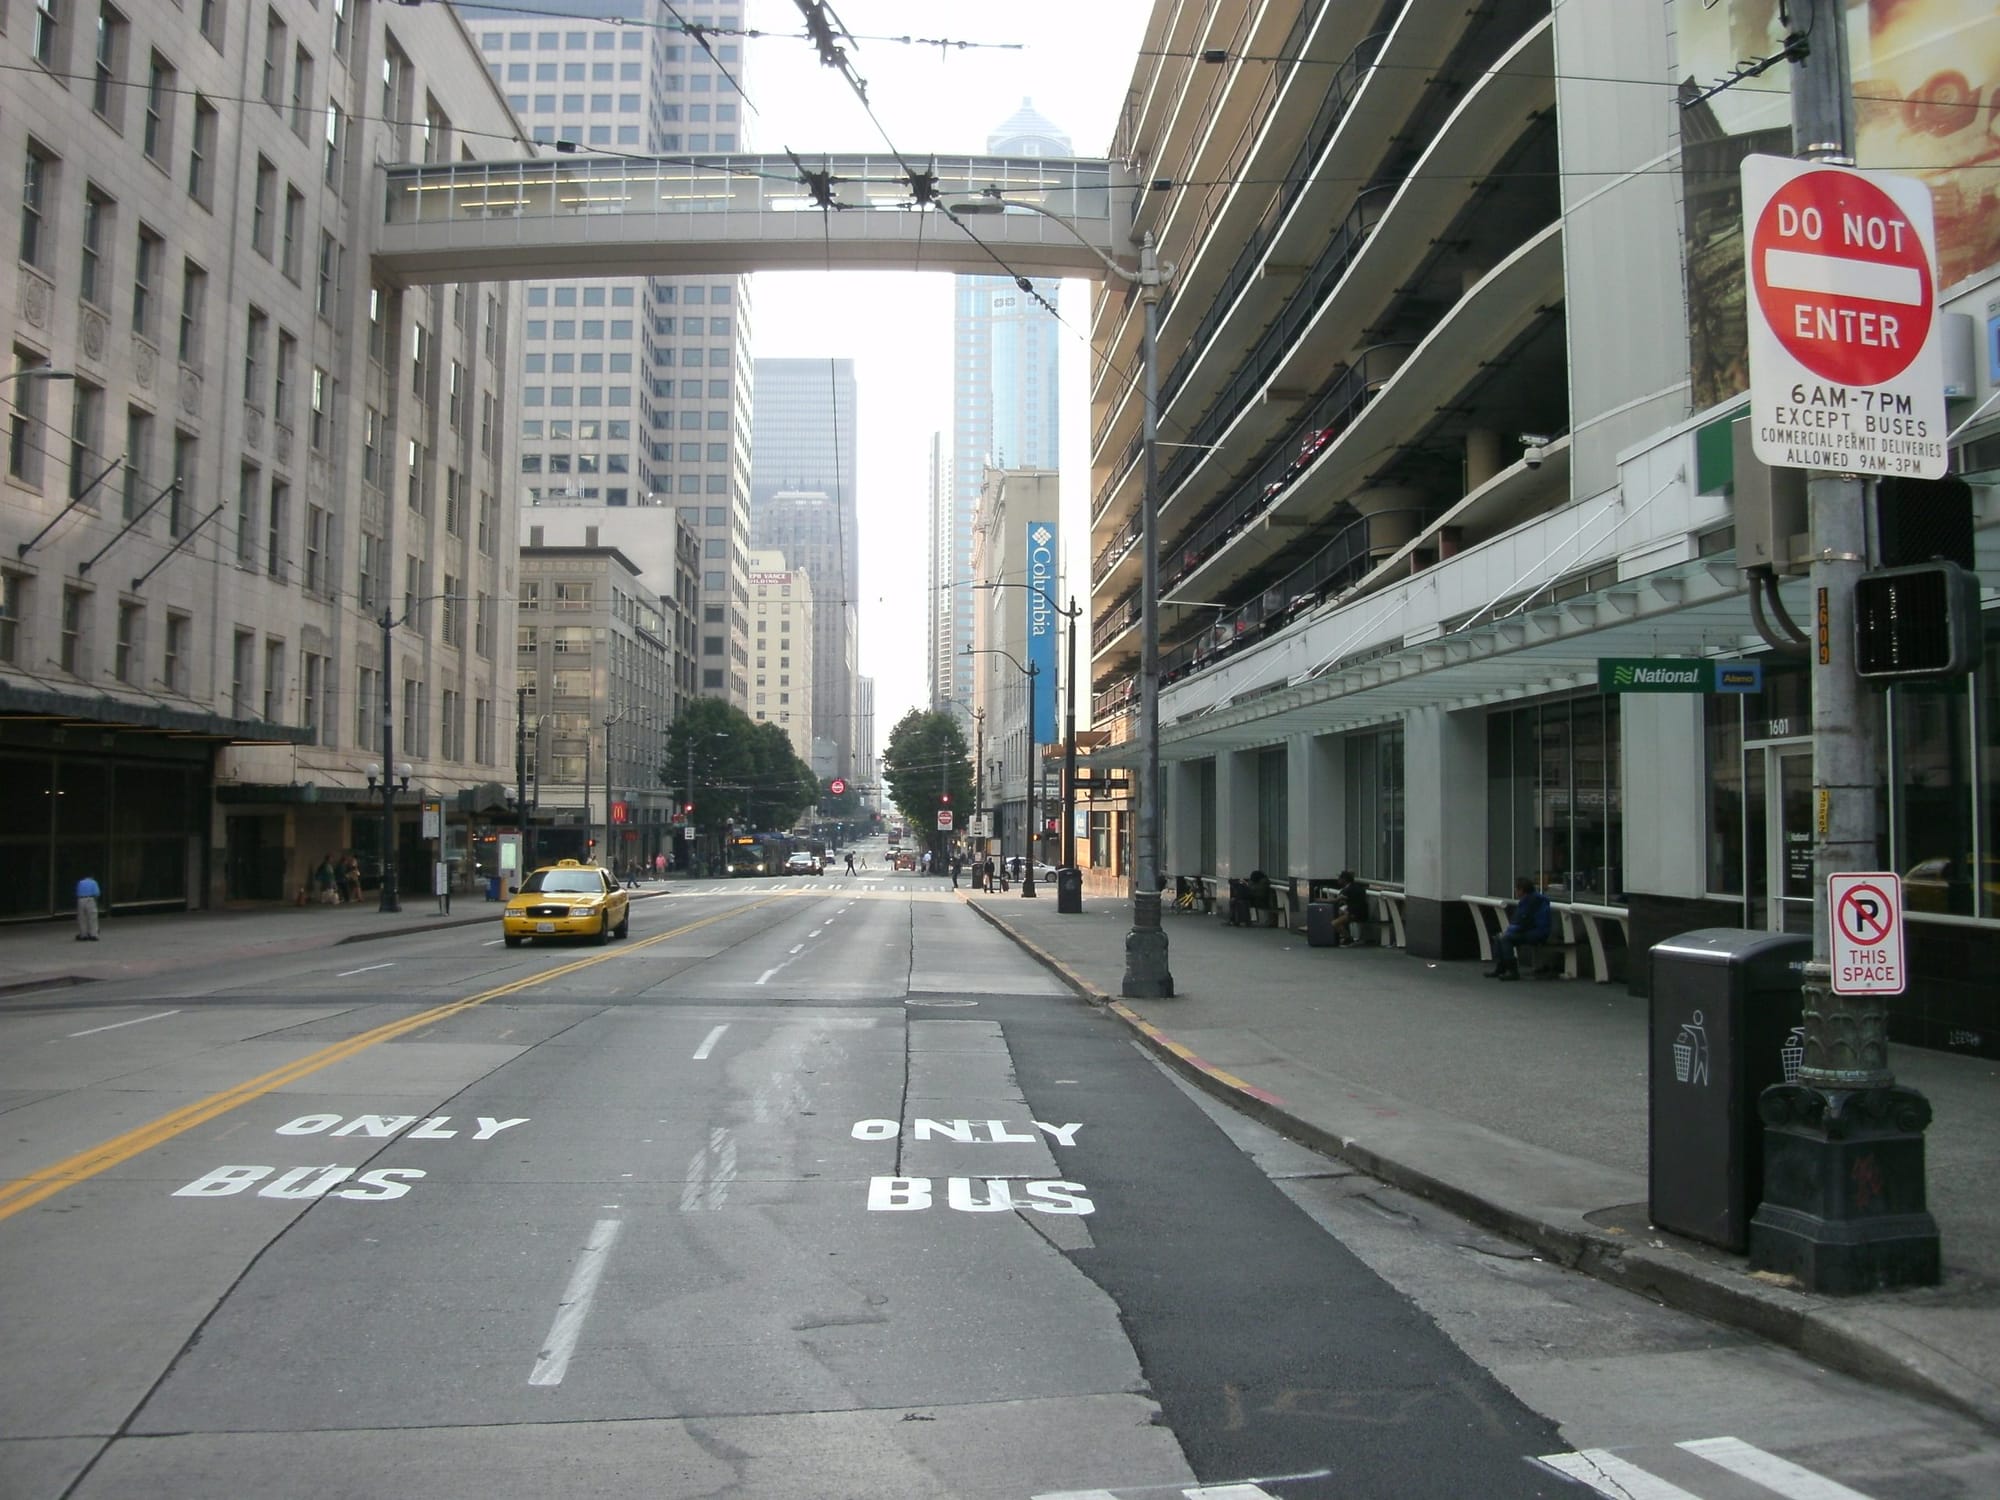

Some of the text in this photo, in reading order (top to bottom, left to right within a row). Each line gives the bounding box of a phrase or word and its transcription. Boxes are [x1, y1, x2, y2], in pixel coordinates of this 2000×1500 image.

[1777, 204, 1905, 253] DO NOT
[1794, 304, 1900, 349] ENTER
[1791, 384, 1912, 415] 6AM-7PM
[1776, 406, 1927, 438] EXCEPT BUSES
[1761, 427, 1942, 458] COMMERCIAL PERMIT DELIVERIES
[1787, 449, 1848, 467] ALLOWED
[1033, 547, 1051, 636] Columbia
[1818, 589, 1830, 664] 1609
[1633, 668, 1699, 683] National
[1768, 718, 1789, 736] 1601
[1849, 950, 1887, 964] THIS
[1843, 966, 1895, 981] SPACE
[275, 1113, 532, 1140] ONLY
[851, 1118, 1084, 1146] ONLY
[171, 1163, 428, 1200] BUS
[867, 1176, 1096, 1215] BUS
